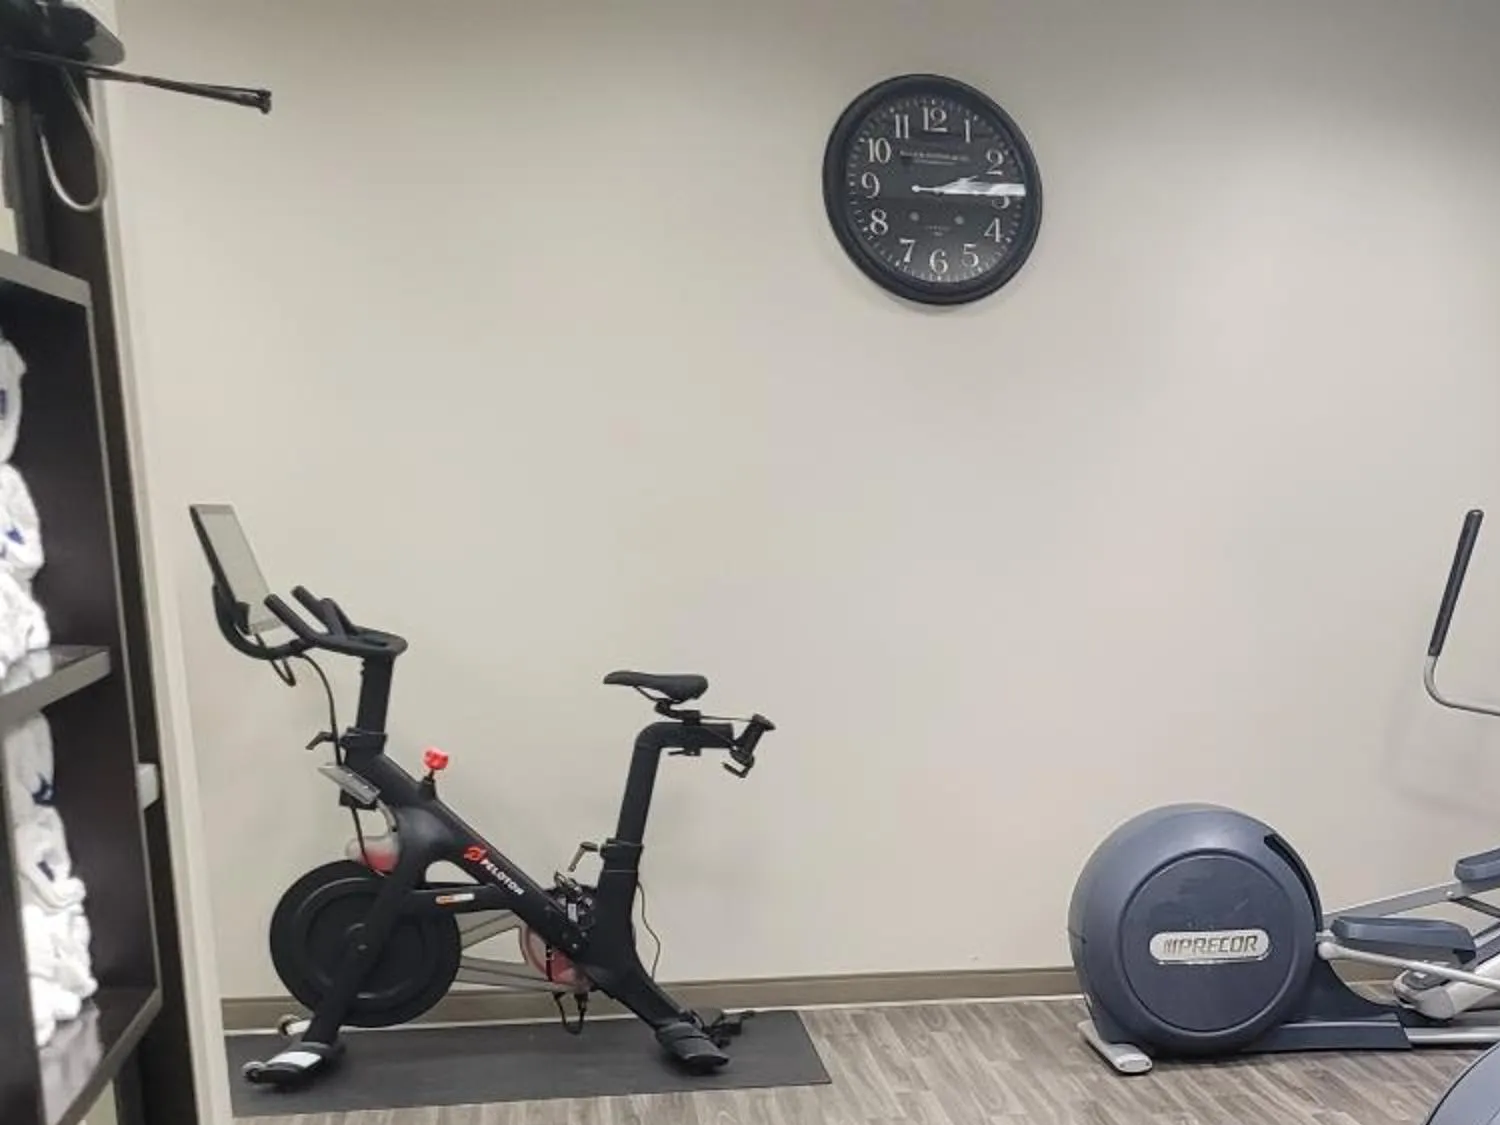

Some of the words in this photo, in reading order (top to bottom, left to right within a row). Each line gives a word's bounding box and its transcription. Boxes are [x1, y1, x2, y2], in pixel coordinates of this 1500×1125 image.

[894, 113, 910, 139] 11
[923, 107, 948, 132] 12
[965, 118, 972, 143] 1
[867, 137, 892, 164] 10
[986, 150, 1004, 175] 2
[861, 172, 881, 199] 9
[869, 208, 889, 235] 8
[984, 218, 1005, 243] 4
[900, 238, 916, 263] 7
[929, 249, 948, 275] 6
[962, 243, 979, 268] 5
[480, 858, 526, 896] PELOTON
[1176, 935, 1258, 955] PRECOR
